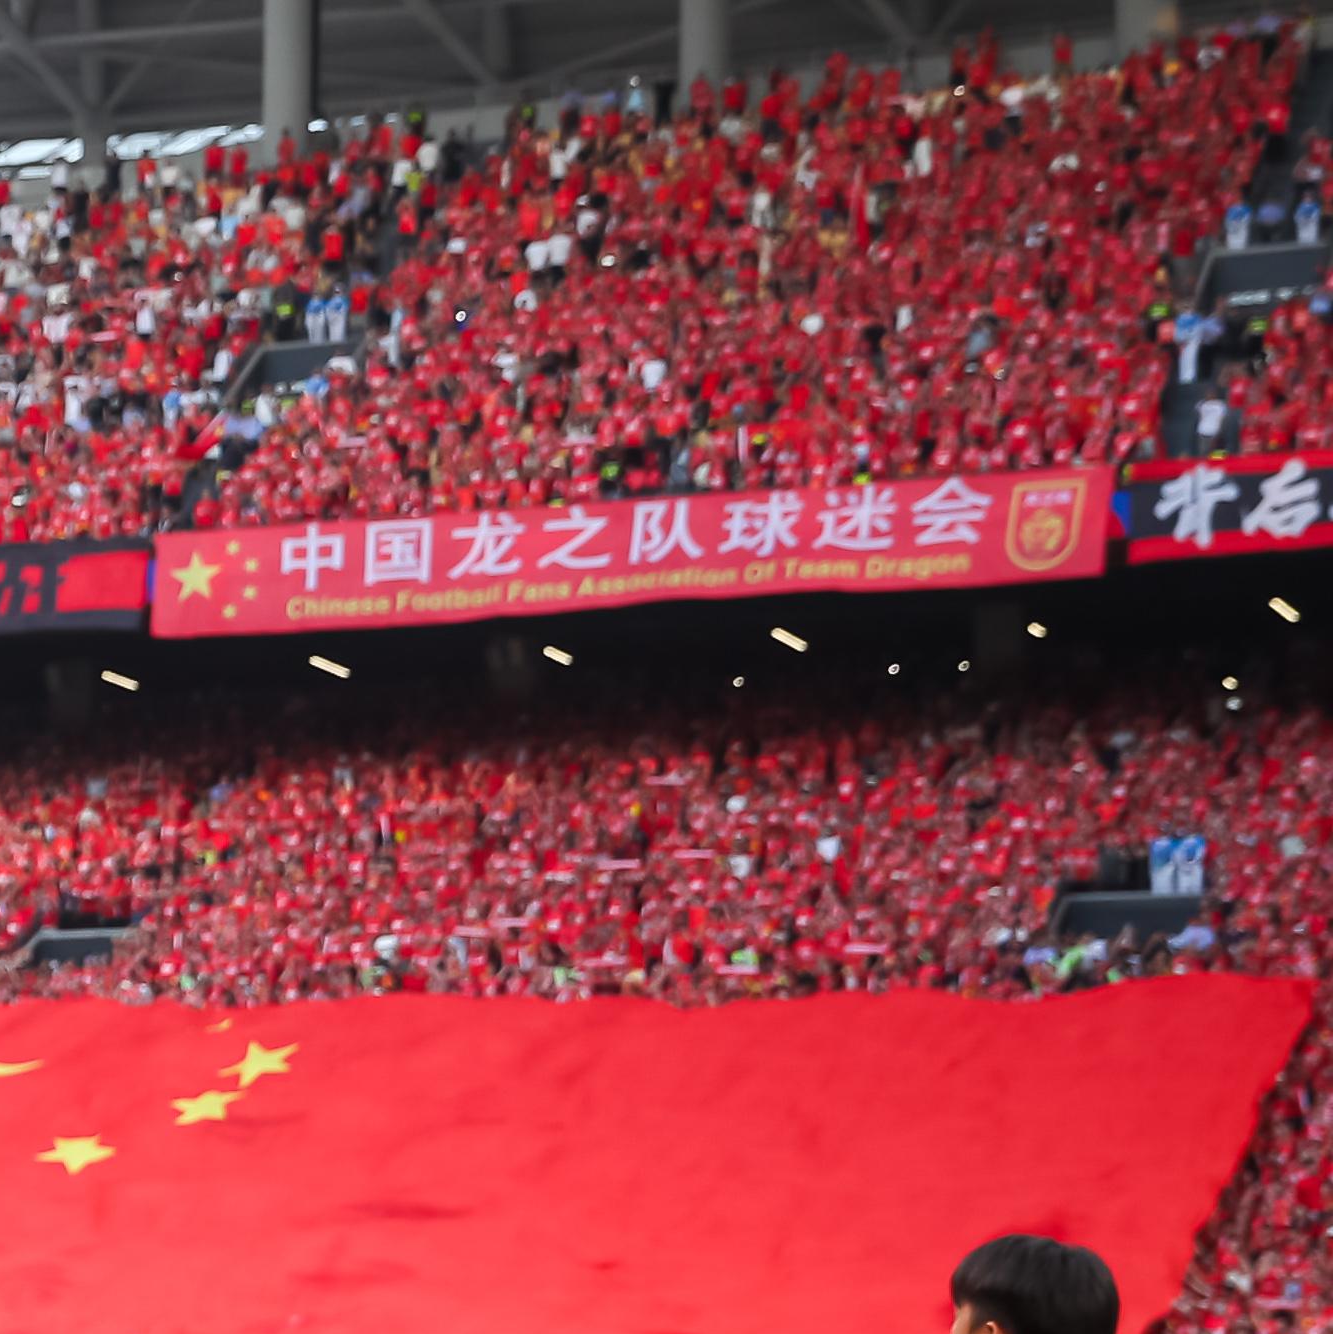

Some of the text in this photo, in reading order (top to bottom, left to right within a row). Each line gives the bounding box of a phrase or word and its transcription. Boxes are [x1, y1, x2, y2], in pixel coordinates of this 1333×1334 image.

[279, 475, 992, 592] 中国龙之队球迷会
[286, 553, 971, 621] Chinese Football Fans Association Of Team Dragon
